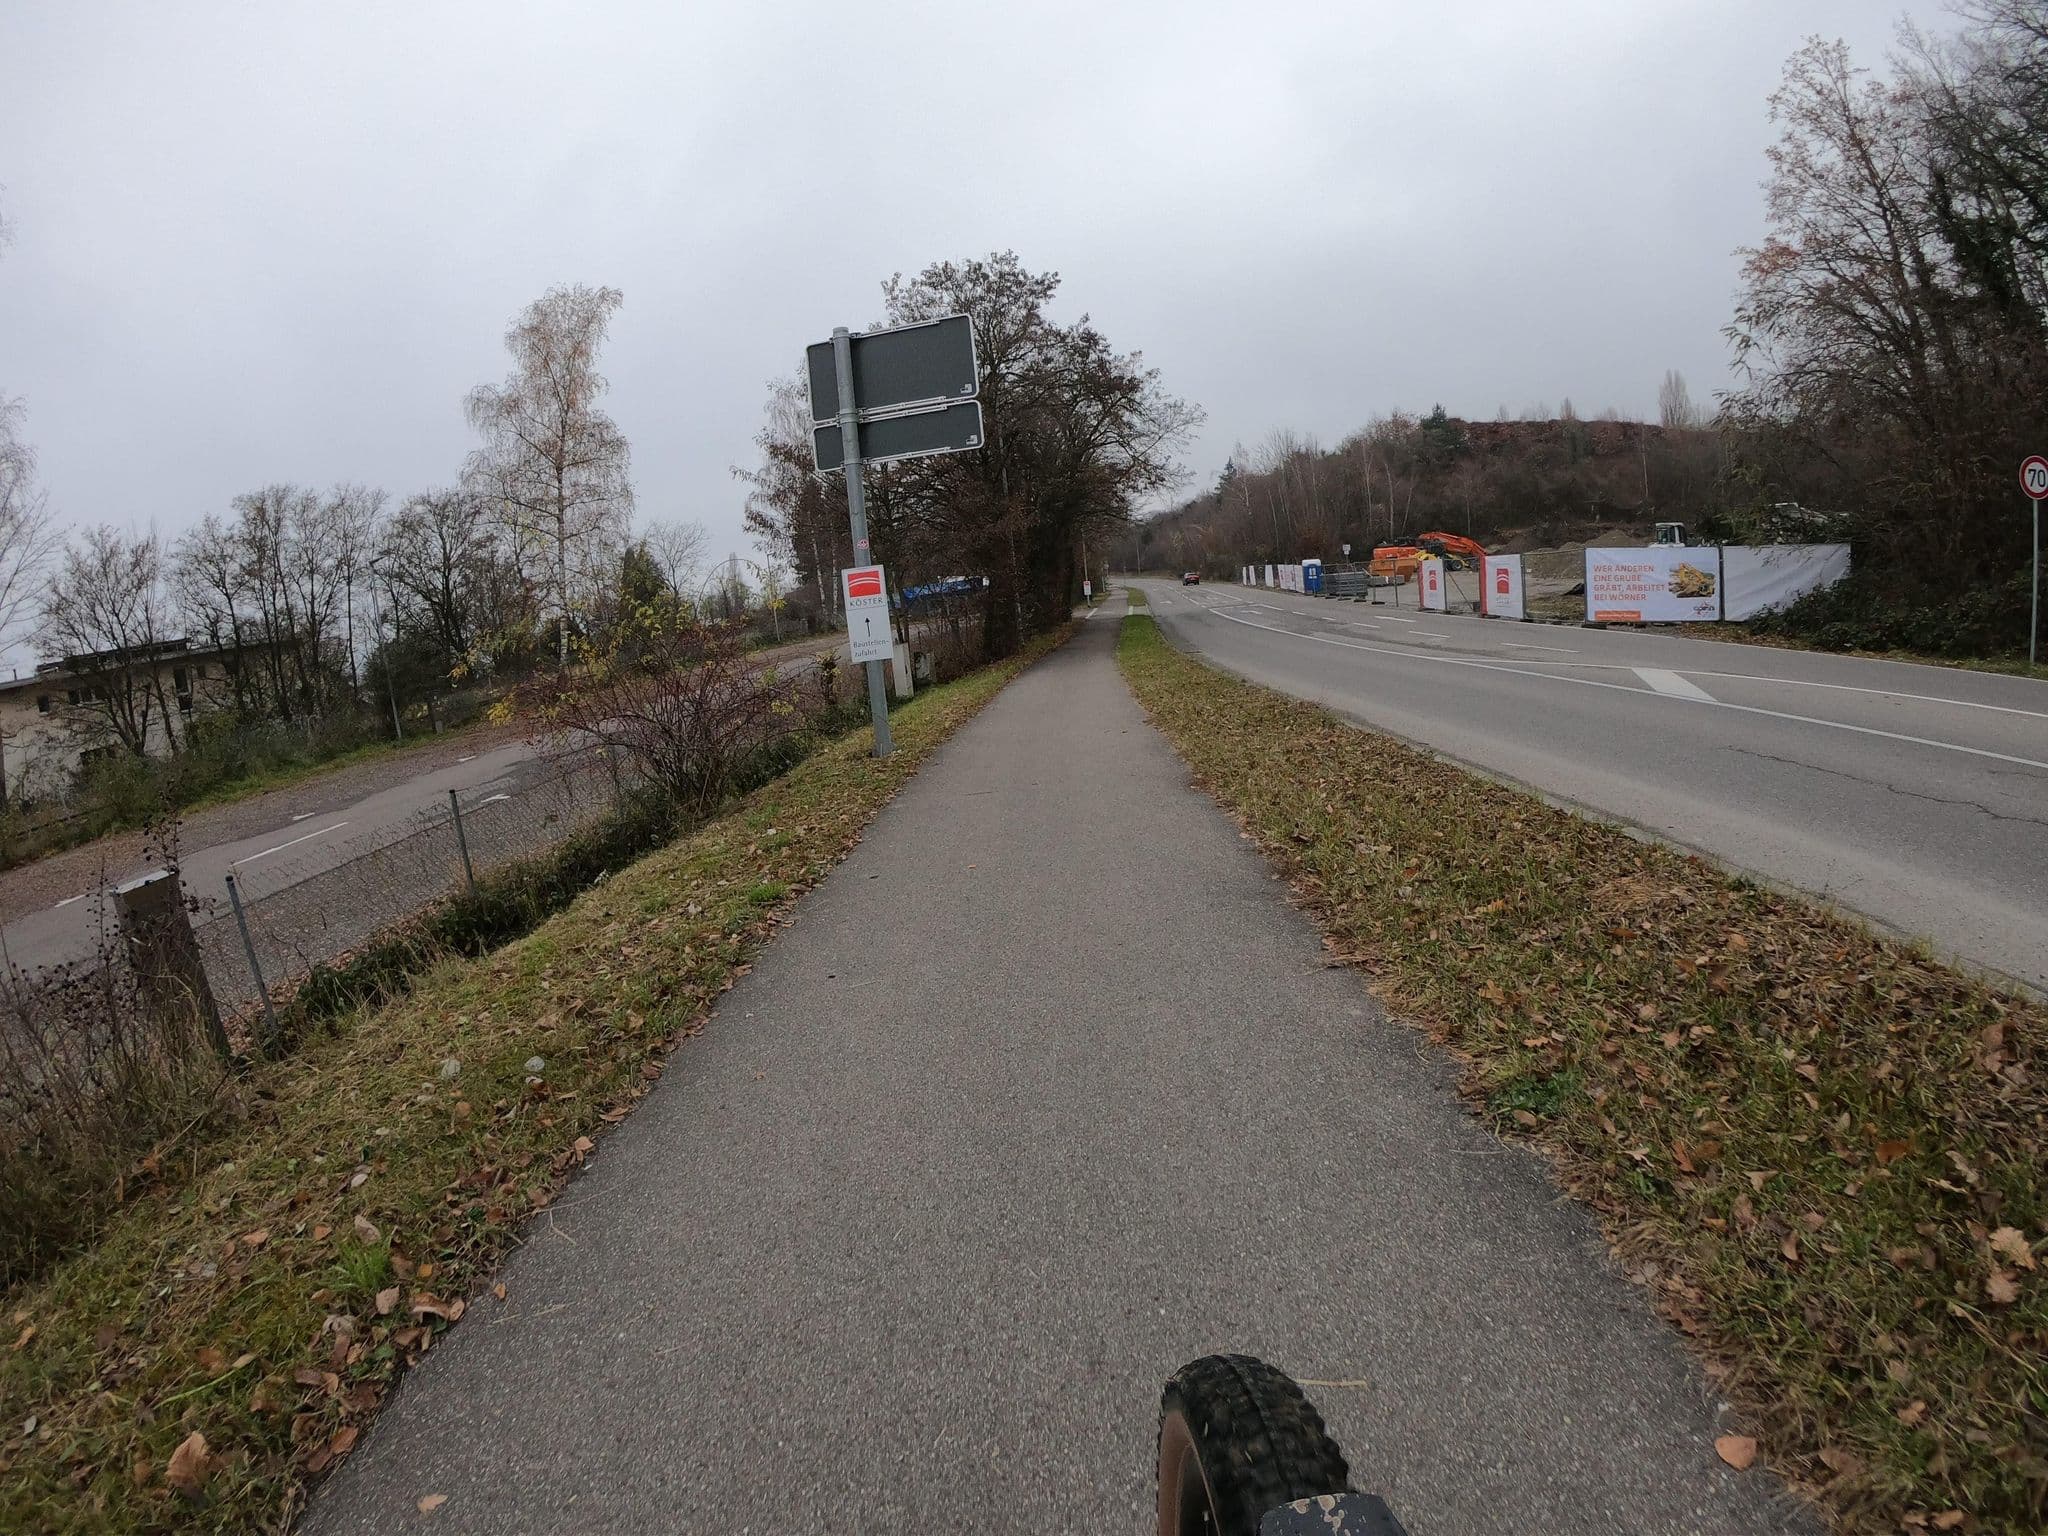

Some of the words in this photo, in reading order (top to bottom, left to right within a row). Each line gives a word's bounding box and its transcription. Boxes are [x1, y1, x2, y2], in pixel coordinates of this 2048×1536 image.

[2028, 469, 2045, 487] 70
[1593, 564, 1612, 572] WER
[1615, 564, 1654, 572] ANDEREN
[1593, 574, 1612, 582] EINE
[1613, 574, 1642, 582] GRUBE
[1625, 583, 1665, 592] ARBEITET
[1594, 593, 1607, 601] BEI
[849, 598, 883, 607] KÖSTER
